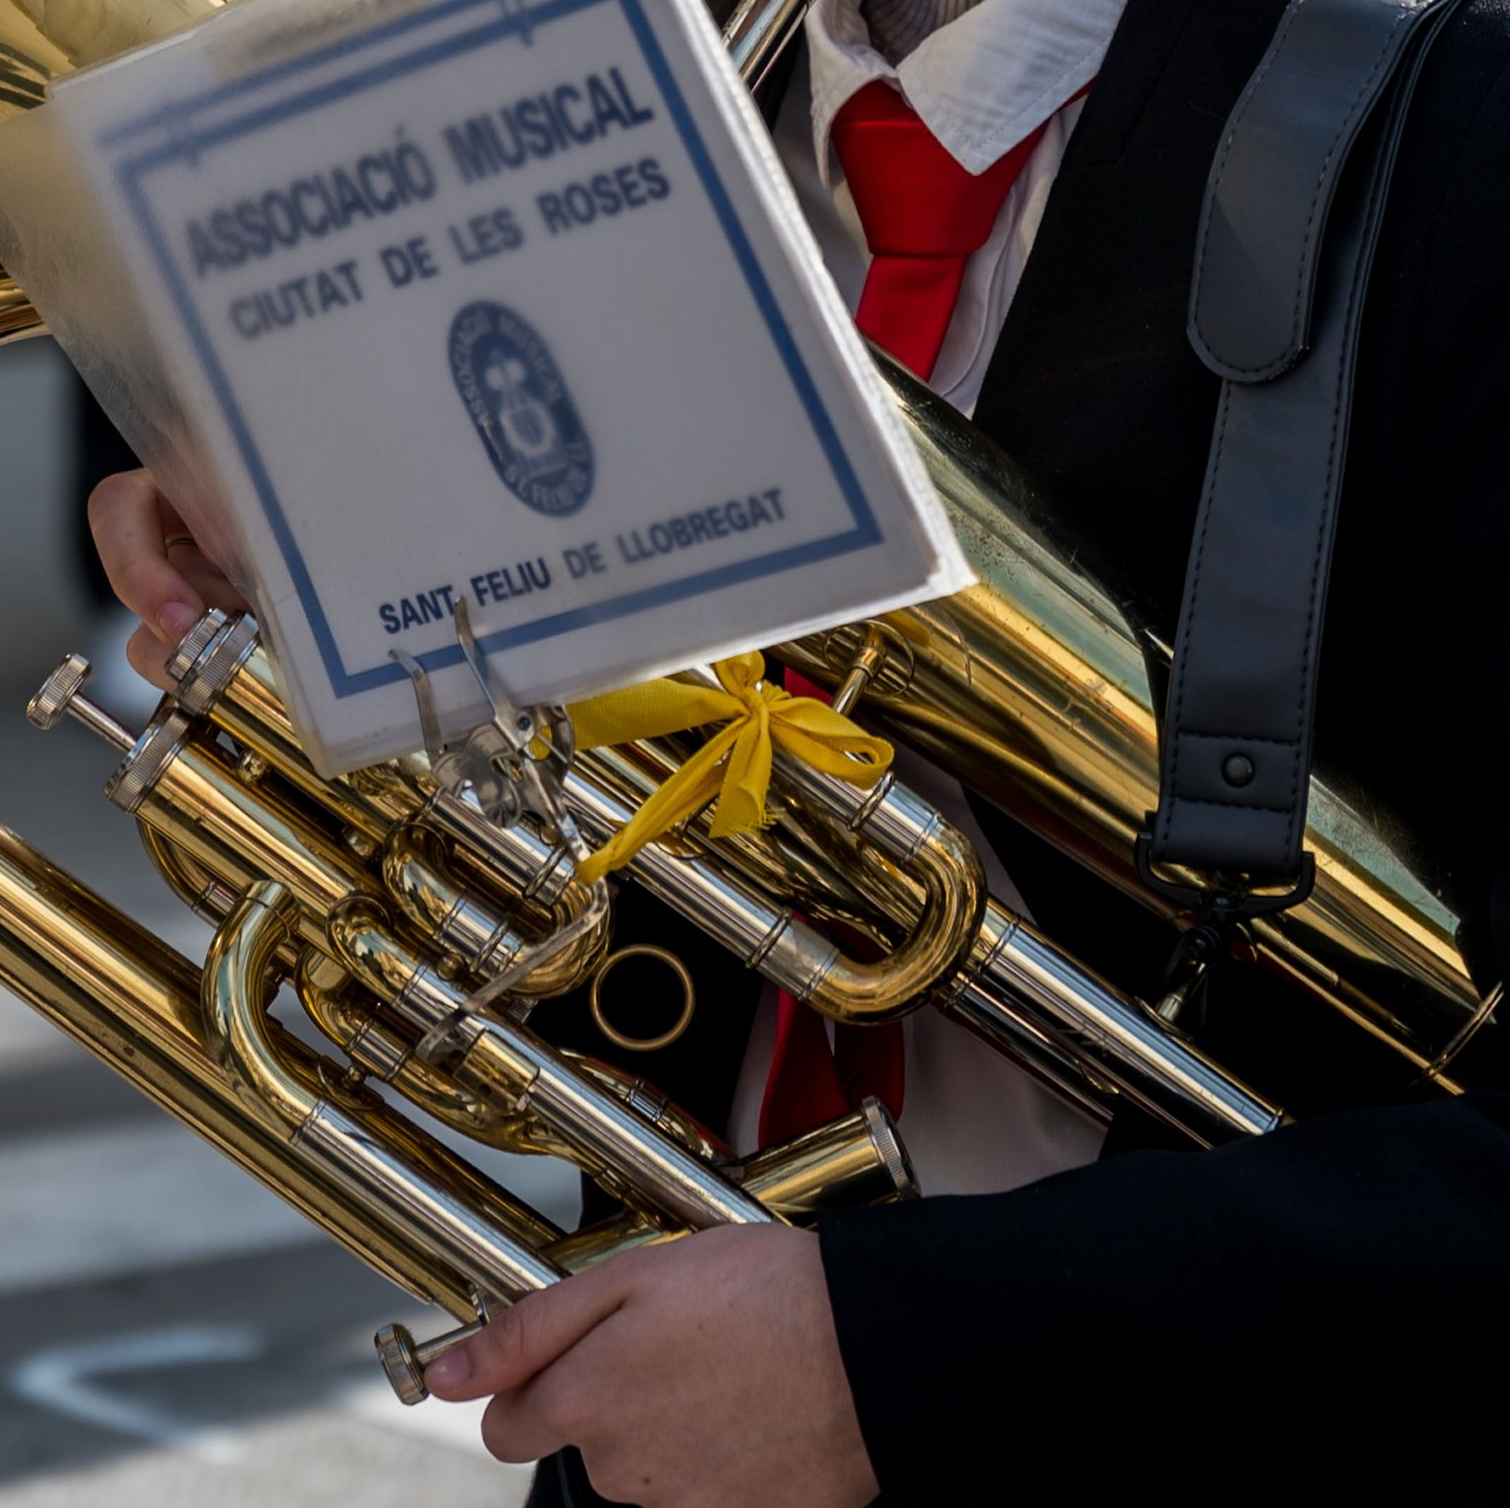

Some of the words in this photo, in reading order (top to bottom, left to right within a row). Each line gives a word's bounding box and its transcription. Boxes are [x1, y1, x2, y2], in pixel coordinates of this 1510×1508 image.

[184, 124, 437, 278] ASSOCIACIÓ
[443, 66, 655, 184] MUSICAL
[228, 260, 365, 340] CIUTAT
[379, 238, 439, 288] DE
[448, 208, 524, 266] LES
[535, 157, 672, 236] ROSES
[378, 584, 458, 635] SANT
[470, 558, 551, 607] FELIU
[563, 542, 606, 580] DE
[617, 488, 788, 564] LLOBREGAT
